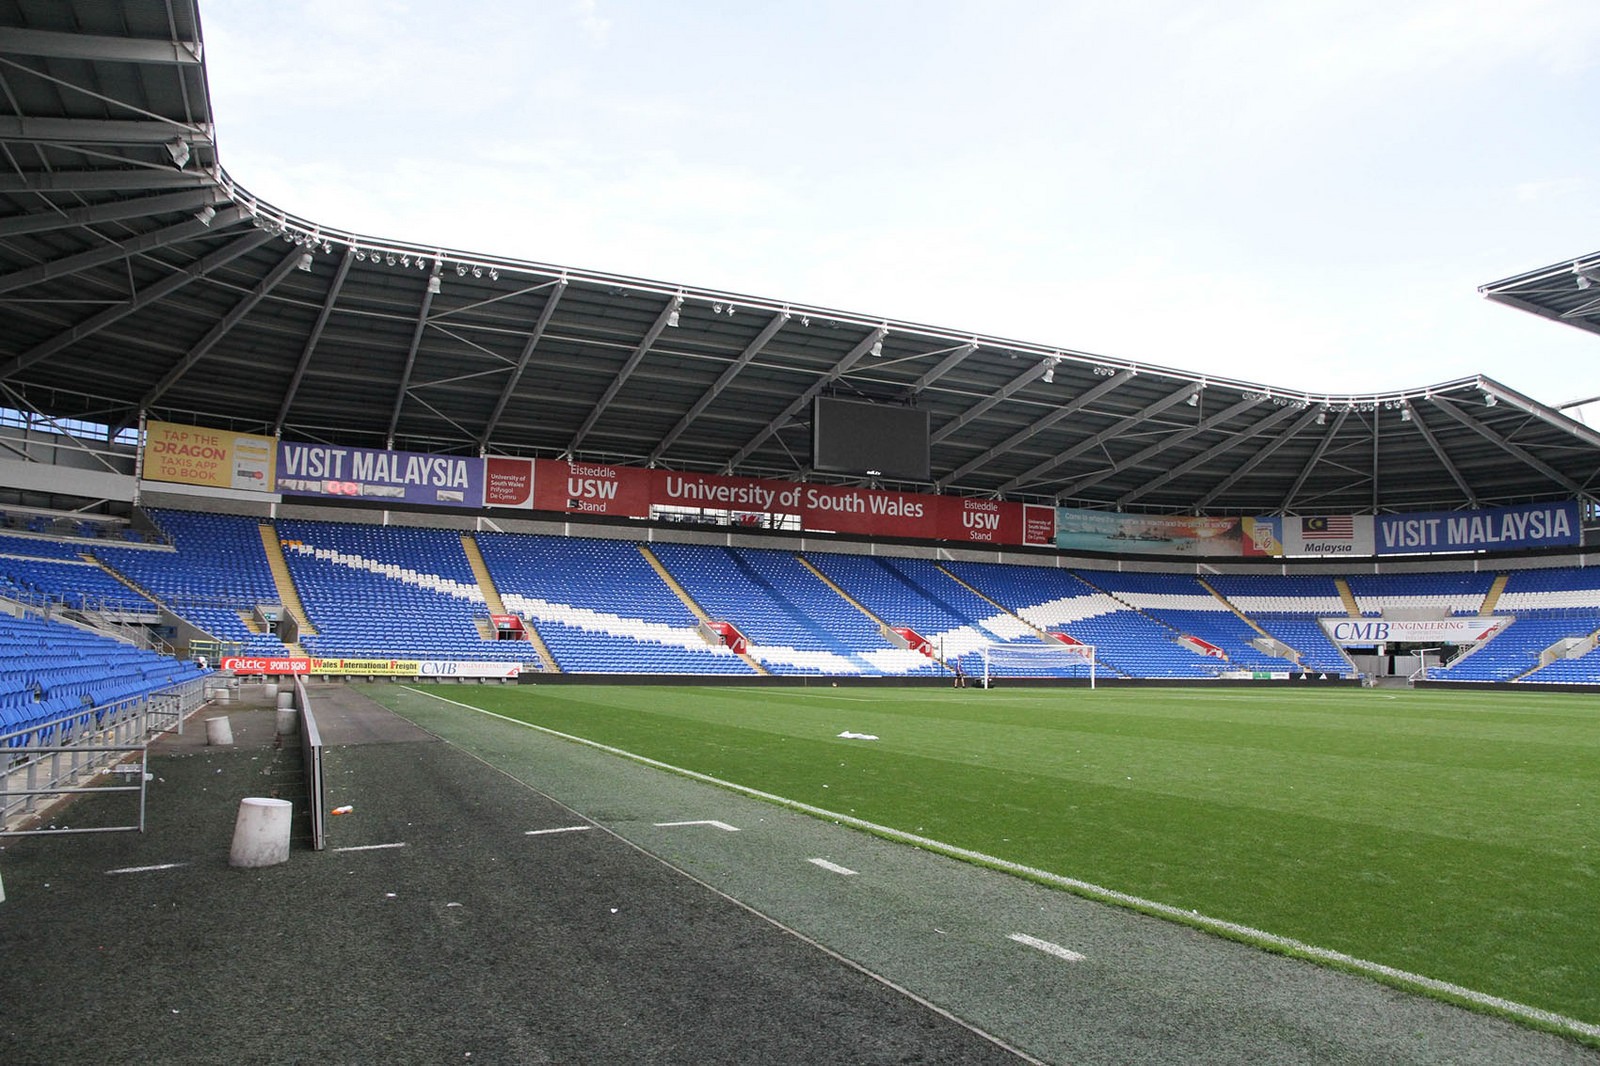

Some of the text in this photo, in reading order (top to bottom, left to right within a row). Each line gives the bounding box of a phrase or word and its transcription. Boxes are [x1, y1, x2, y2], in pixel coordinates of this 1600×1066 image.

[163, 429, 219, 446] TAP THE
[153, 441, 227, 460] DRAGON
[160, 456, 217, 470] TAXIS APP
[283, 445, 469, 488] VISIT MALAYSIA
[160, 466, 216, 480] TO BOOK
[570, 464, 616, 478] Eisteddle
[568, 477, 618, 499] USW
[665, 476, 924, 518] University of South Wales
[577, 501, 606, 512] Stand
[964, 500, 998, 511] Eisteddle
[963, 511, 1000, 530] USW
[1382, 508, 1572, 548] VISIT MALAYSIA
[970, 530, 992, 541] Stand
[1304, 543, 1352, 553] Malaysia
[1334, 622, 1390, 640] CMB
[1391, 621, 1464, 630] ENGINEERING
[270, 661, 290, 671] SPORTS
[291, 661, 306, 671] SIGNS
[312, 659, 417, 670] Wales International Freight
[421, 662, 458, 675] CMB
